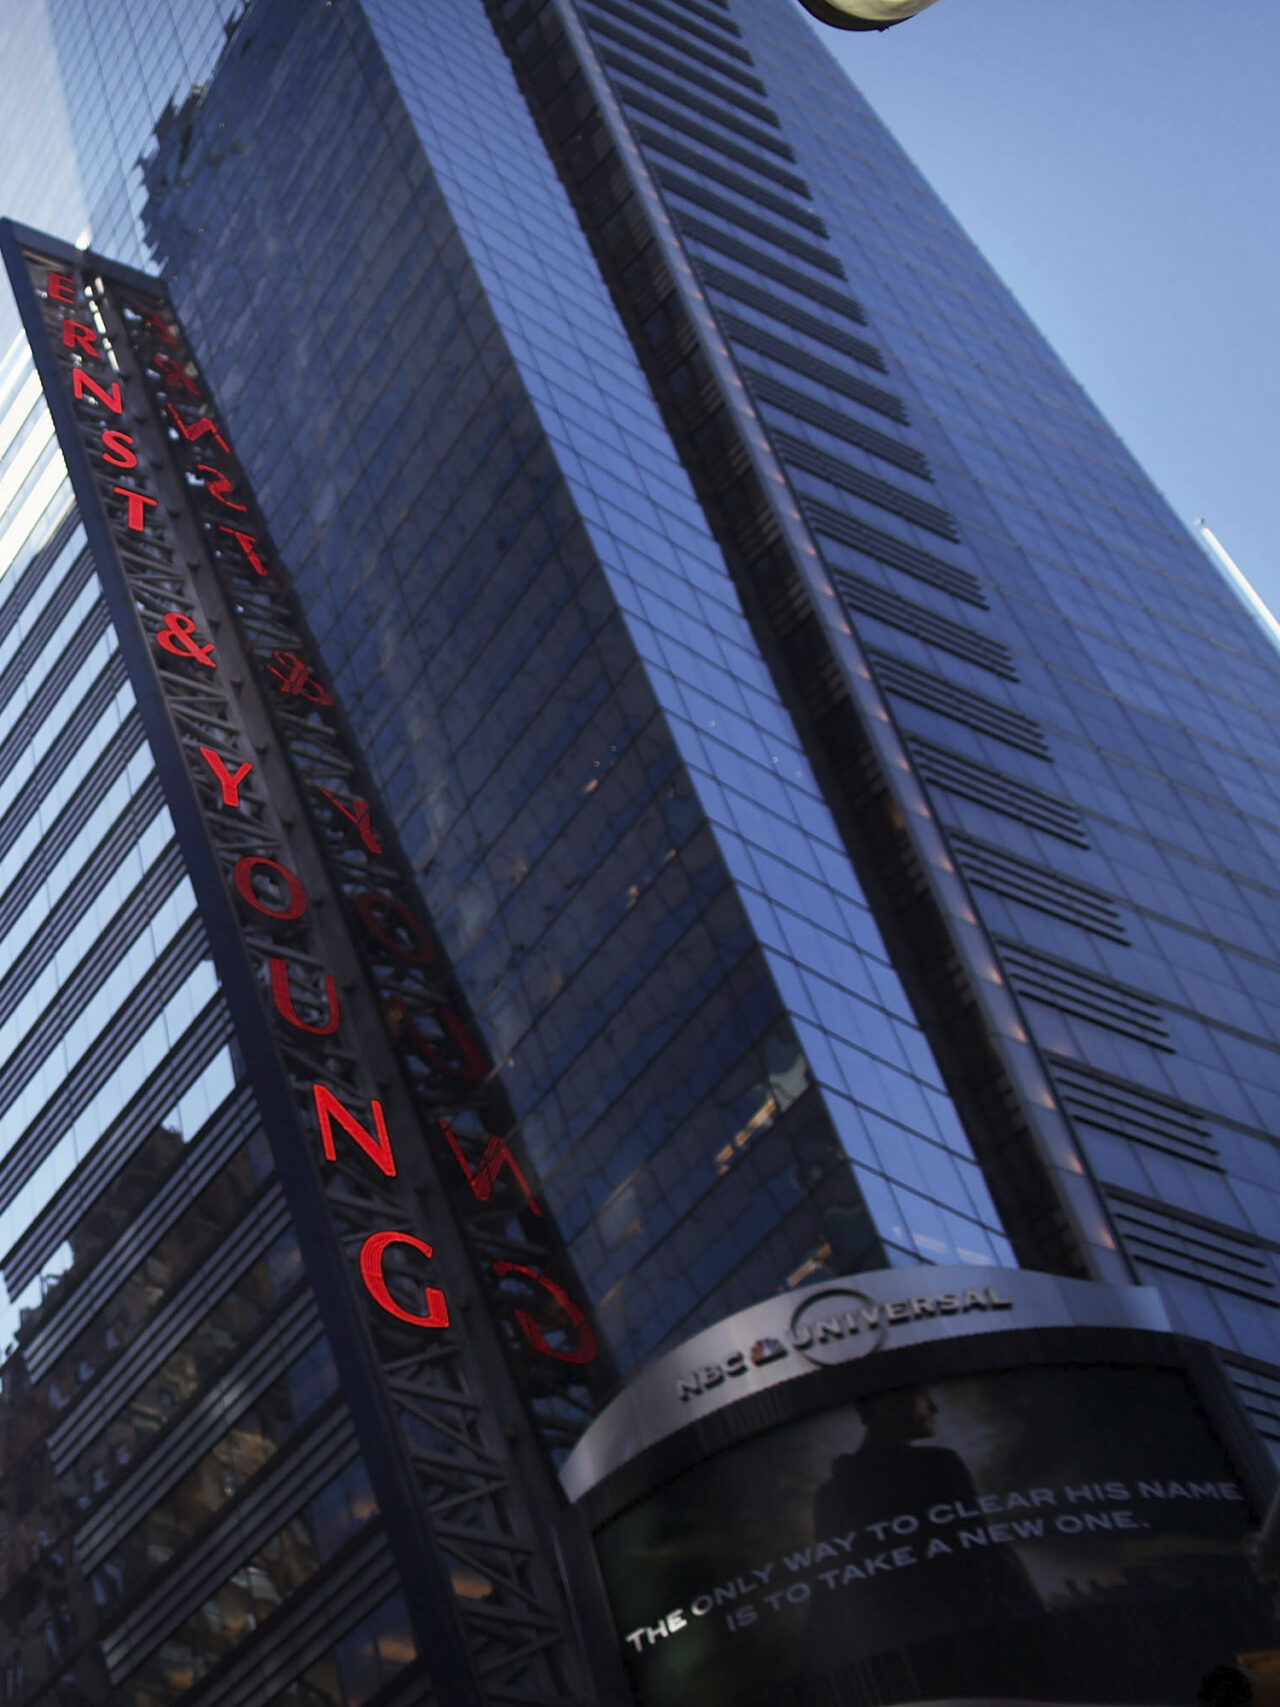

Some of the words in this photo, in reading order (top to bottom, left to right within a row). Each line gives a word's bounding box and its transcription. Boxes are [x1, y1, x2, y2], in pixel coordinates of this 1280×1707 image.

[46, 272, 158, 532] ERNST
[156, 612, 217, 668] &
[199, 746, 450, 1329] YOUNG
[676, 1350, 748, 1402] NBC
[786, 1286, 1013, 1351] UNIVERSAL
[625, 1607, 688, 1653] THE
[690, 1562, 774, 1617] ONLY
[782, 1530, 857, 1573] WAY
[865, 1514, 919, 1542] TO
[927, 1487, 1058, 1526] CLEAR
[1064, 1481, 1131, 1504] HIS
[1136, 1479, 1245, 1501] NAME
[725, 1604, 758, 1632] IS
[764, 1582, 812, 1612] TO
[818, 1545, 917, 1591] TAKE
[927, 1537, 953, 1560] A
[958, 1519, 1045, 1550] NEW
[1055, 1509, 1151, 1535] ONE.
